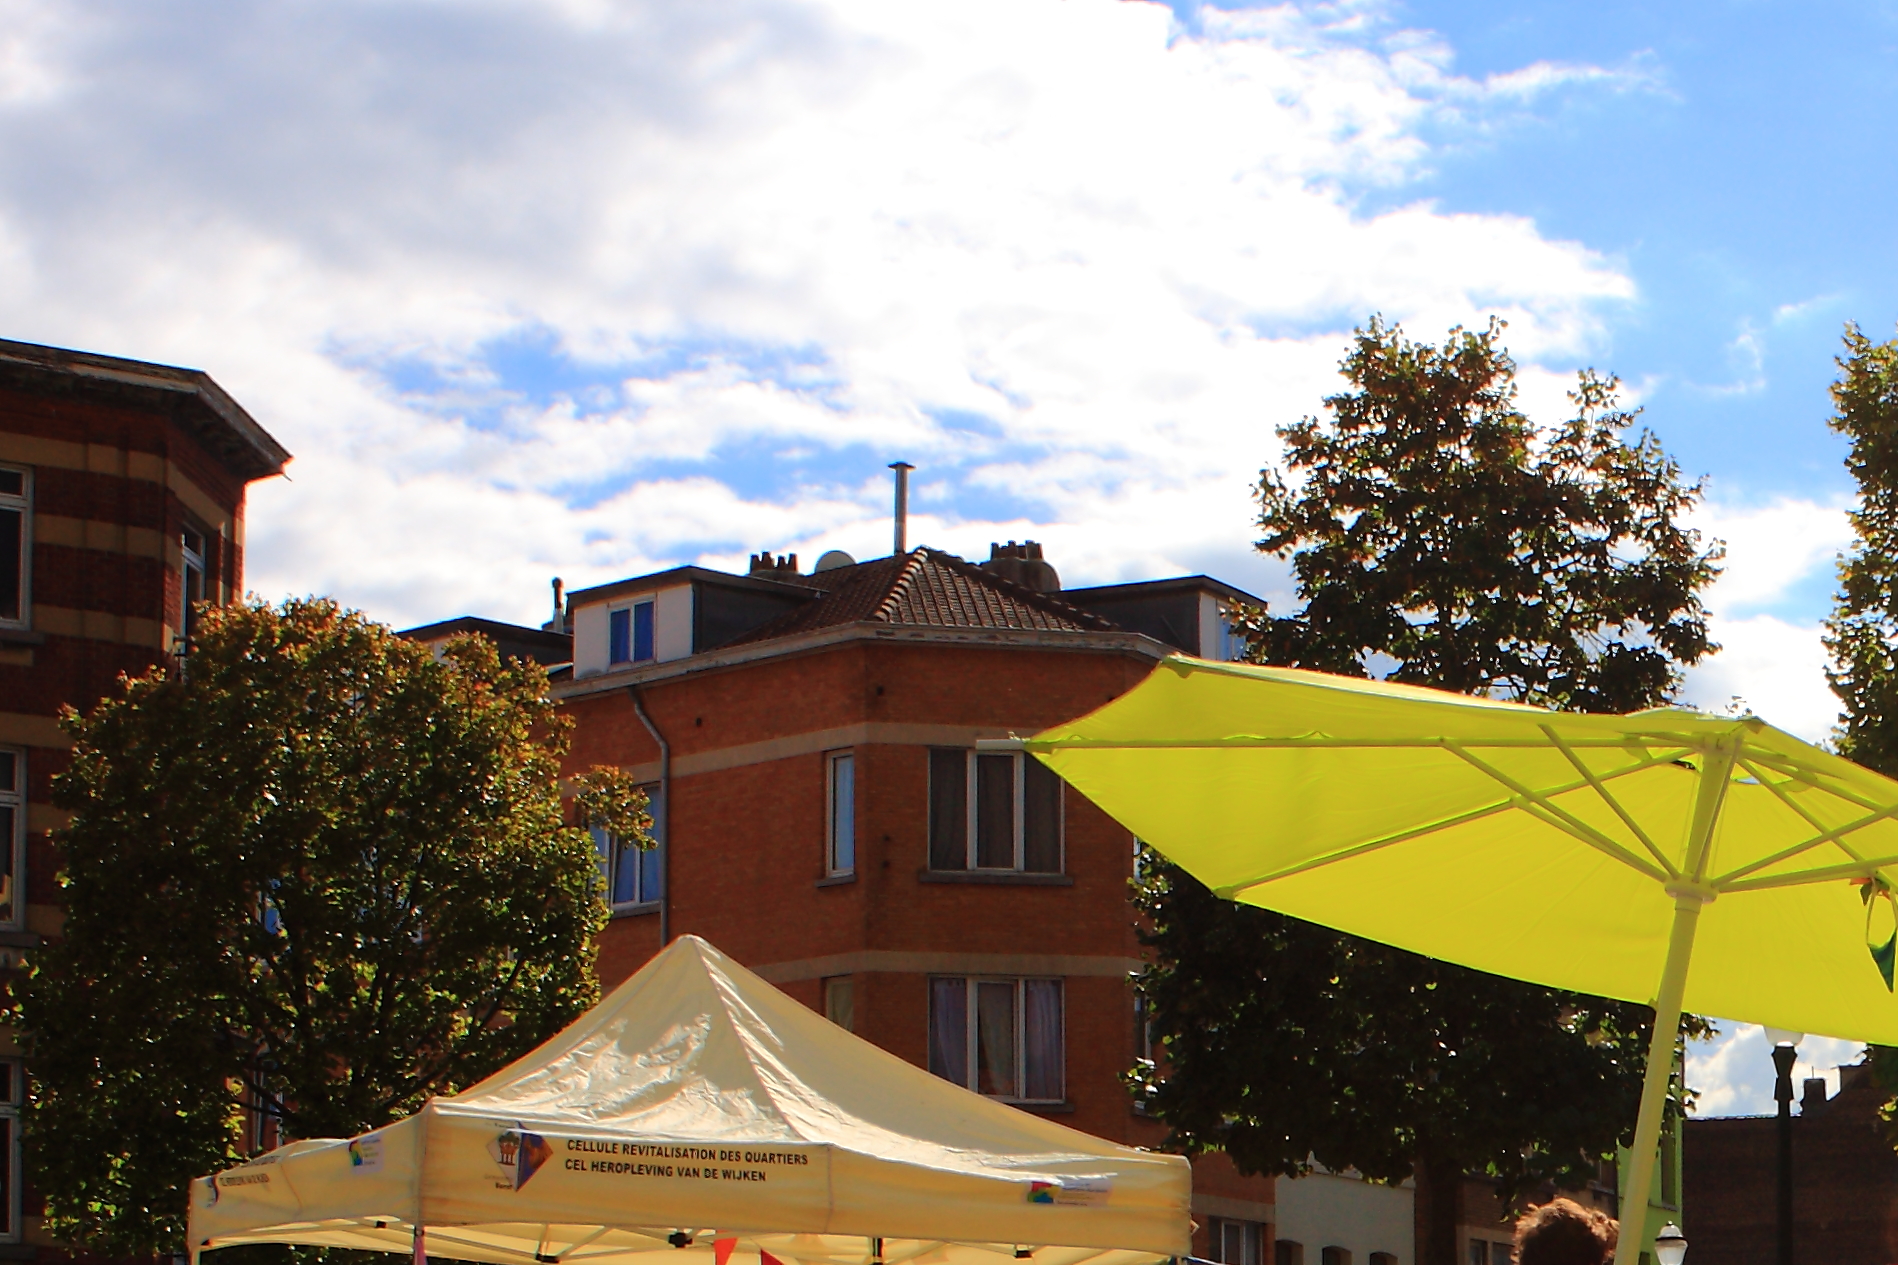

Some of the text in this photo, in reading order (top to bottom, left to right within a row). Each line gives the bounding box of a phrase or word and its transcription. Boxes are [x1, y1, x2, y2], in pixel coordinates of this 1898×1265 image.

[567, 1139, 808, 1165] CELLULE REVITALISATION DES QUARTIERS
[565, 1159, 766, 1181] CEL HEROPLEVING VAN DE WIJKEN
